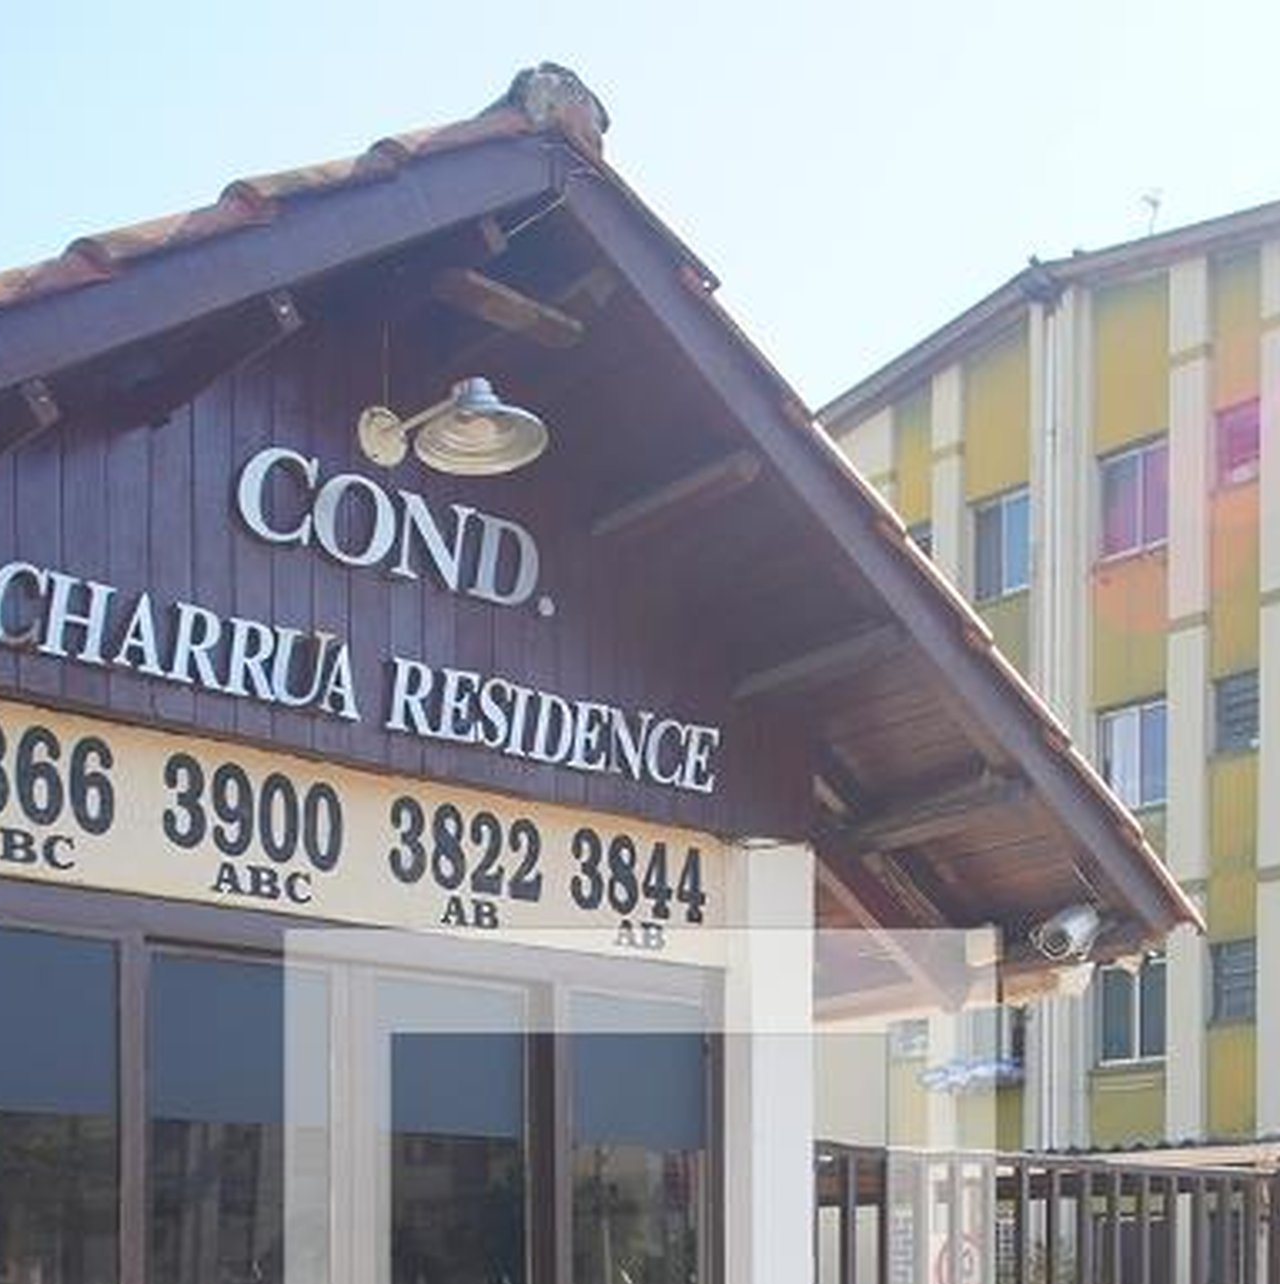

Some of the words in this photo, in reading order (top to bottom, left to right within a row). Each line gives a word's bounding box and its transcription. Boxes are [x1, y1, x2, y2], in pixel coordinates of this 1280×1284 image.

[238, 447, 554, 617] COND.
[385, 655, 719, 793] RESIDENCE
[162, 752, 342, 871] 3900
[388, 795, 543, 902] 3822
[571, 827, 705, 924] 3844
[211, 862, 314, 904] ABC
[441, 896, 500, 930] AB
[615, 920, 666, 951] AB
